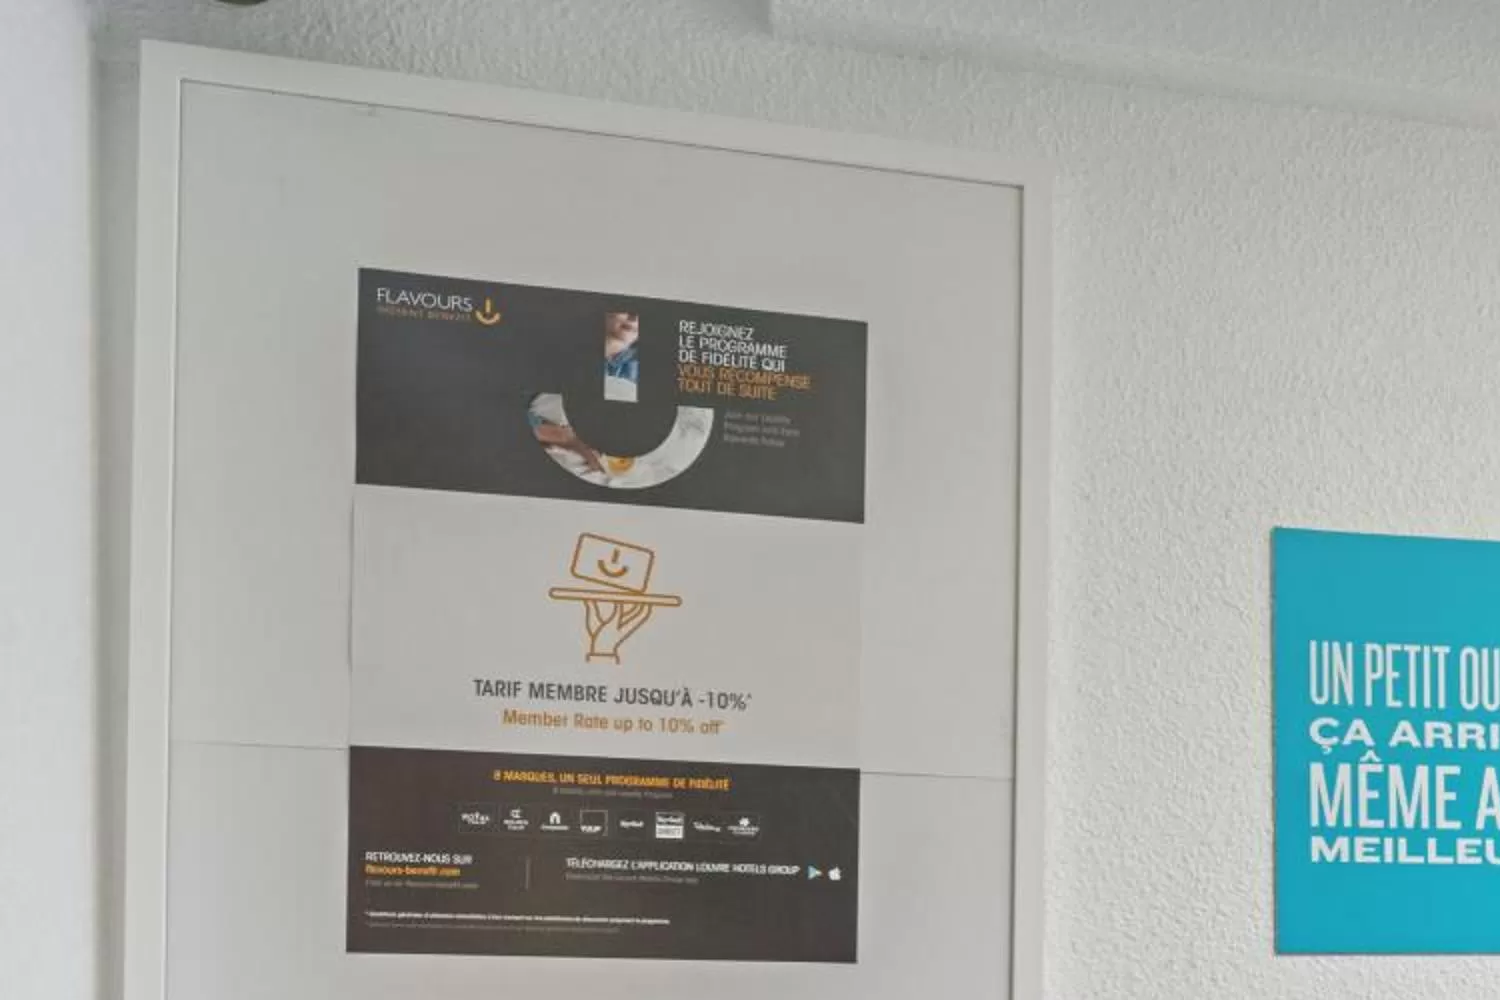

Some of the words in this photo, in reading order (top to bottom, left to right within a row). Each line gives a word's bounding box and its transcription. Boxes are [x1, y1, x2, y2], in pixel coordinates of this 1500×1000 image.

[376, 286, 473, 313] FLAVOURS
[678, 319, 755, 340] REJOIGNEZ
[679, 335, 695, 349] LE
[699, 337, 788, 359] PROGRAMME
[679, 349, 696, 363] DE
[761, 357, 786, 373] QUI
[679, 378, 712, 393] TOUT
[717, 381, 737, 396] DE
[1308, 639, 1354, 706] UN
[1364, 641, 1451, 711] PETIT
[473, 678, 522, 699] TARIF
[529, 682, 608, 704] MEMBRE
[502, 707, 568, 729] Member
[573, 711, 608, 730] Rate
[613, 717, 634, 735] up
[638, 716, 653, 733] to
[660, 717, 695, 735] 10%
[1308, 717, 1375, 755] ÇA
[1308, 749, 1462, 830] MÊME
